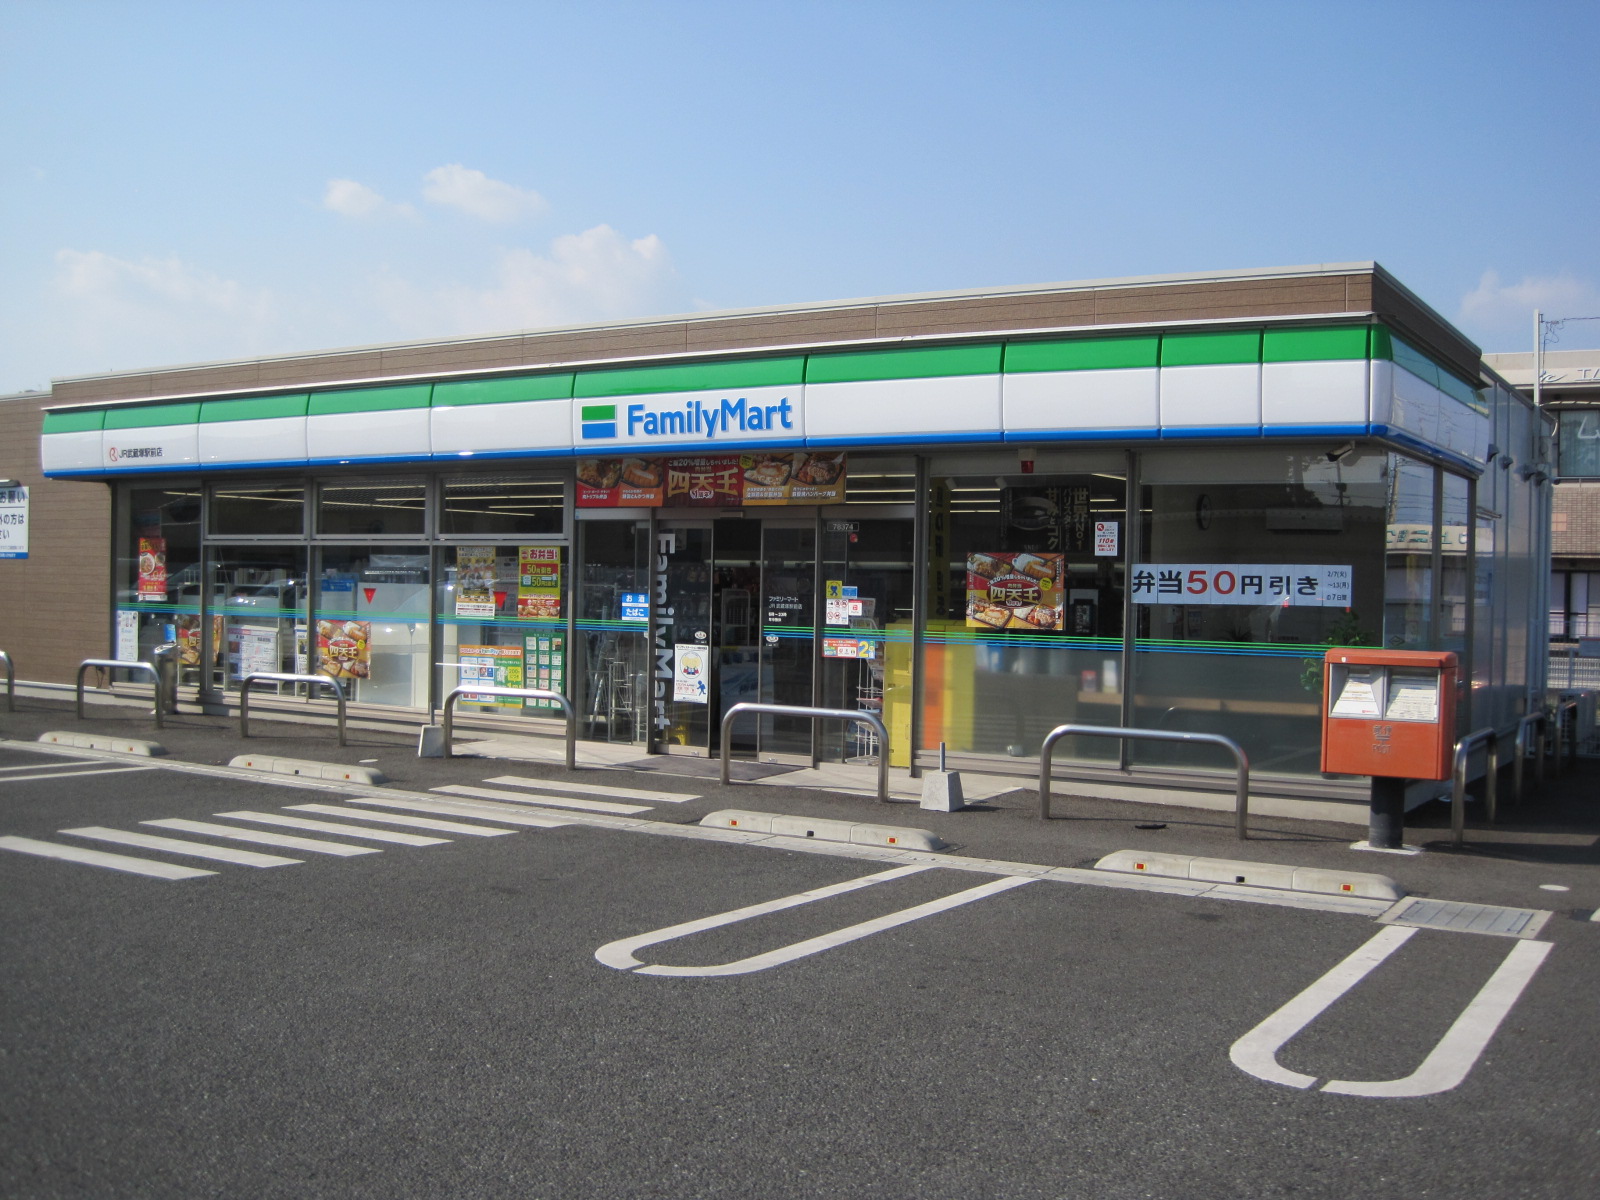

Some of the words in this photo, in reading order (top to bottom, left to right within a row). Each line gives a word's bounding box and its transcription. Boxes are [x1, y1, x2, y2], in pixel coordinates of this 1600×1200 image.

[627, 398, 792, 438] FamilyMart
[667, 466, 739, 498] 四天王
[990, 585, 1040, 604] 四天王
[1132, 570, 1319, 596] 弁当50円引き
[655, 533, 676, 730] FamilyMart
[330, 645, 358, 660] 四天王
